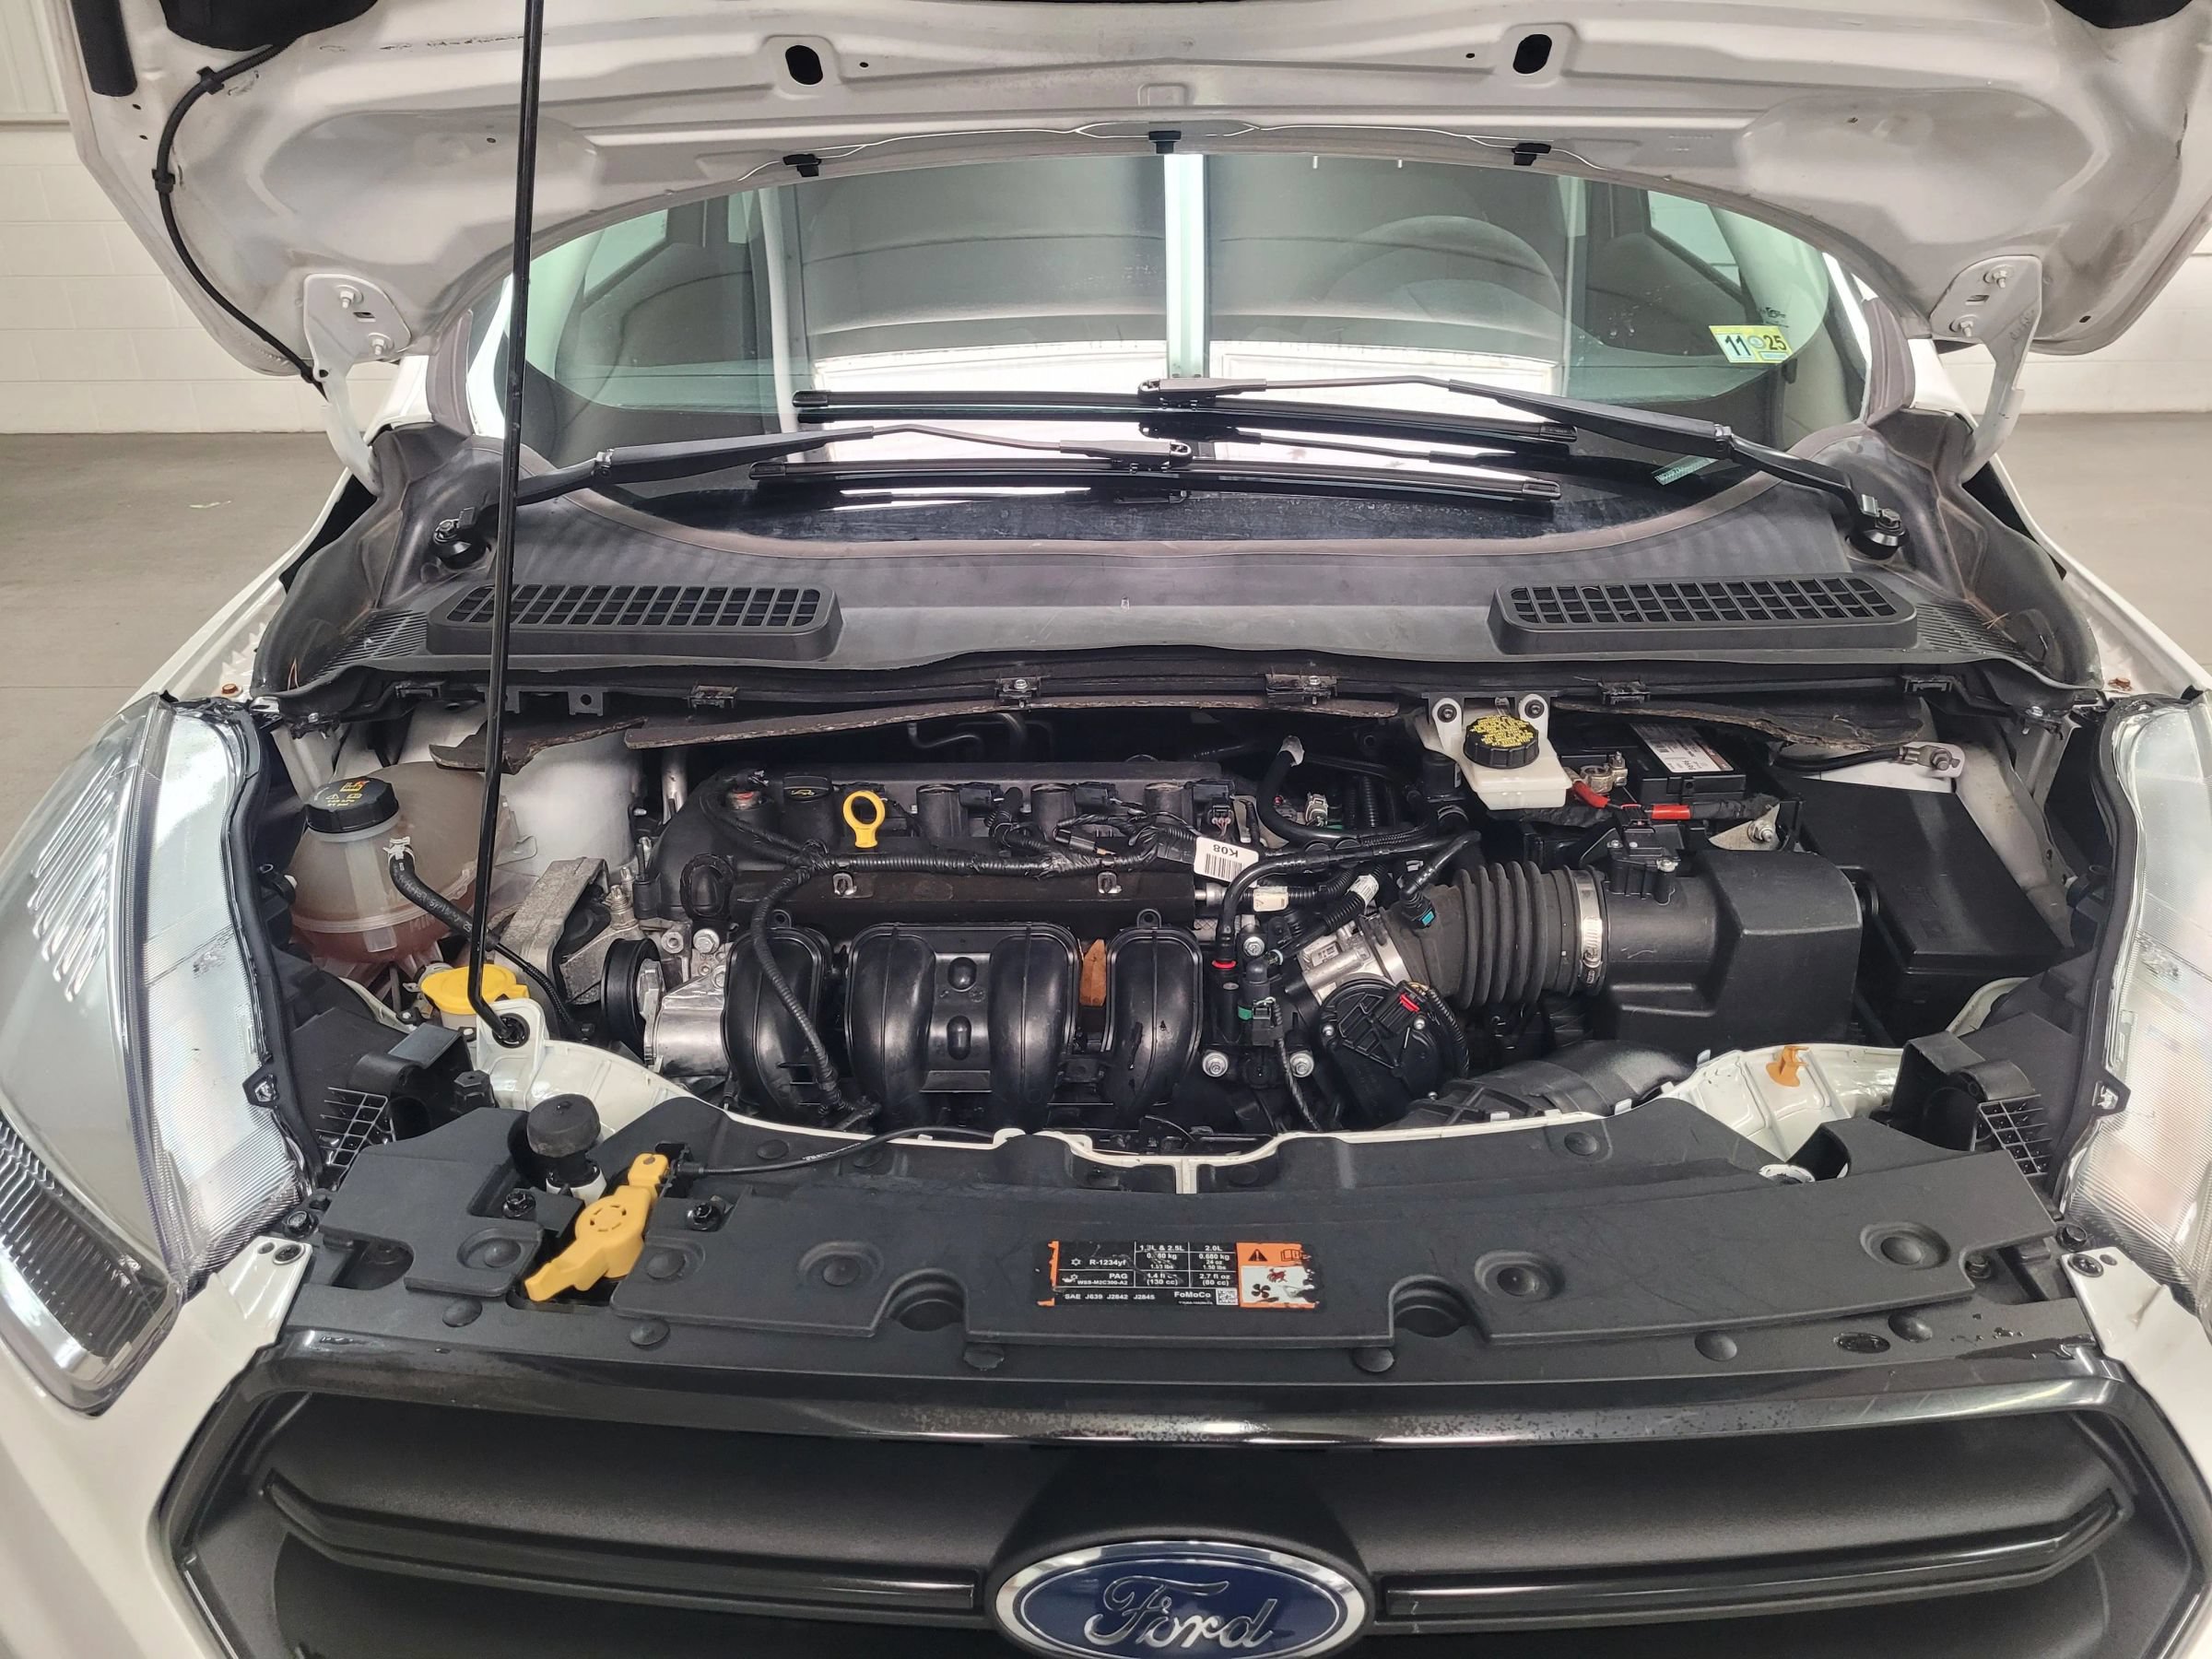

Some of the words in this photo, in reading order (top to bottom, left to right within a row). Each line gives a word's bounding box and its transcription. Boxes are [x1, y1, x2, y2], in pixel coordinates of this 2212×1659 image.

[1724, 335, 1751, 356] 11
[1762, 335, 1787, 350] 25
[1084, 1574, 1278, 1649] Ford
